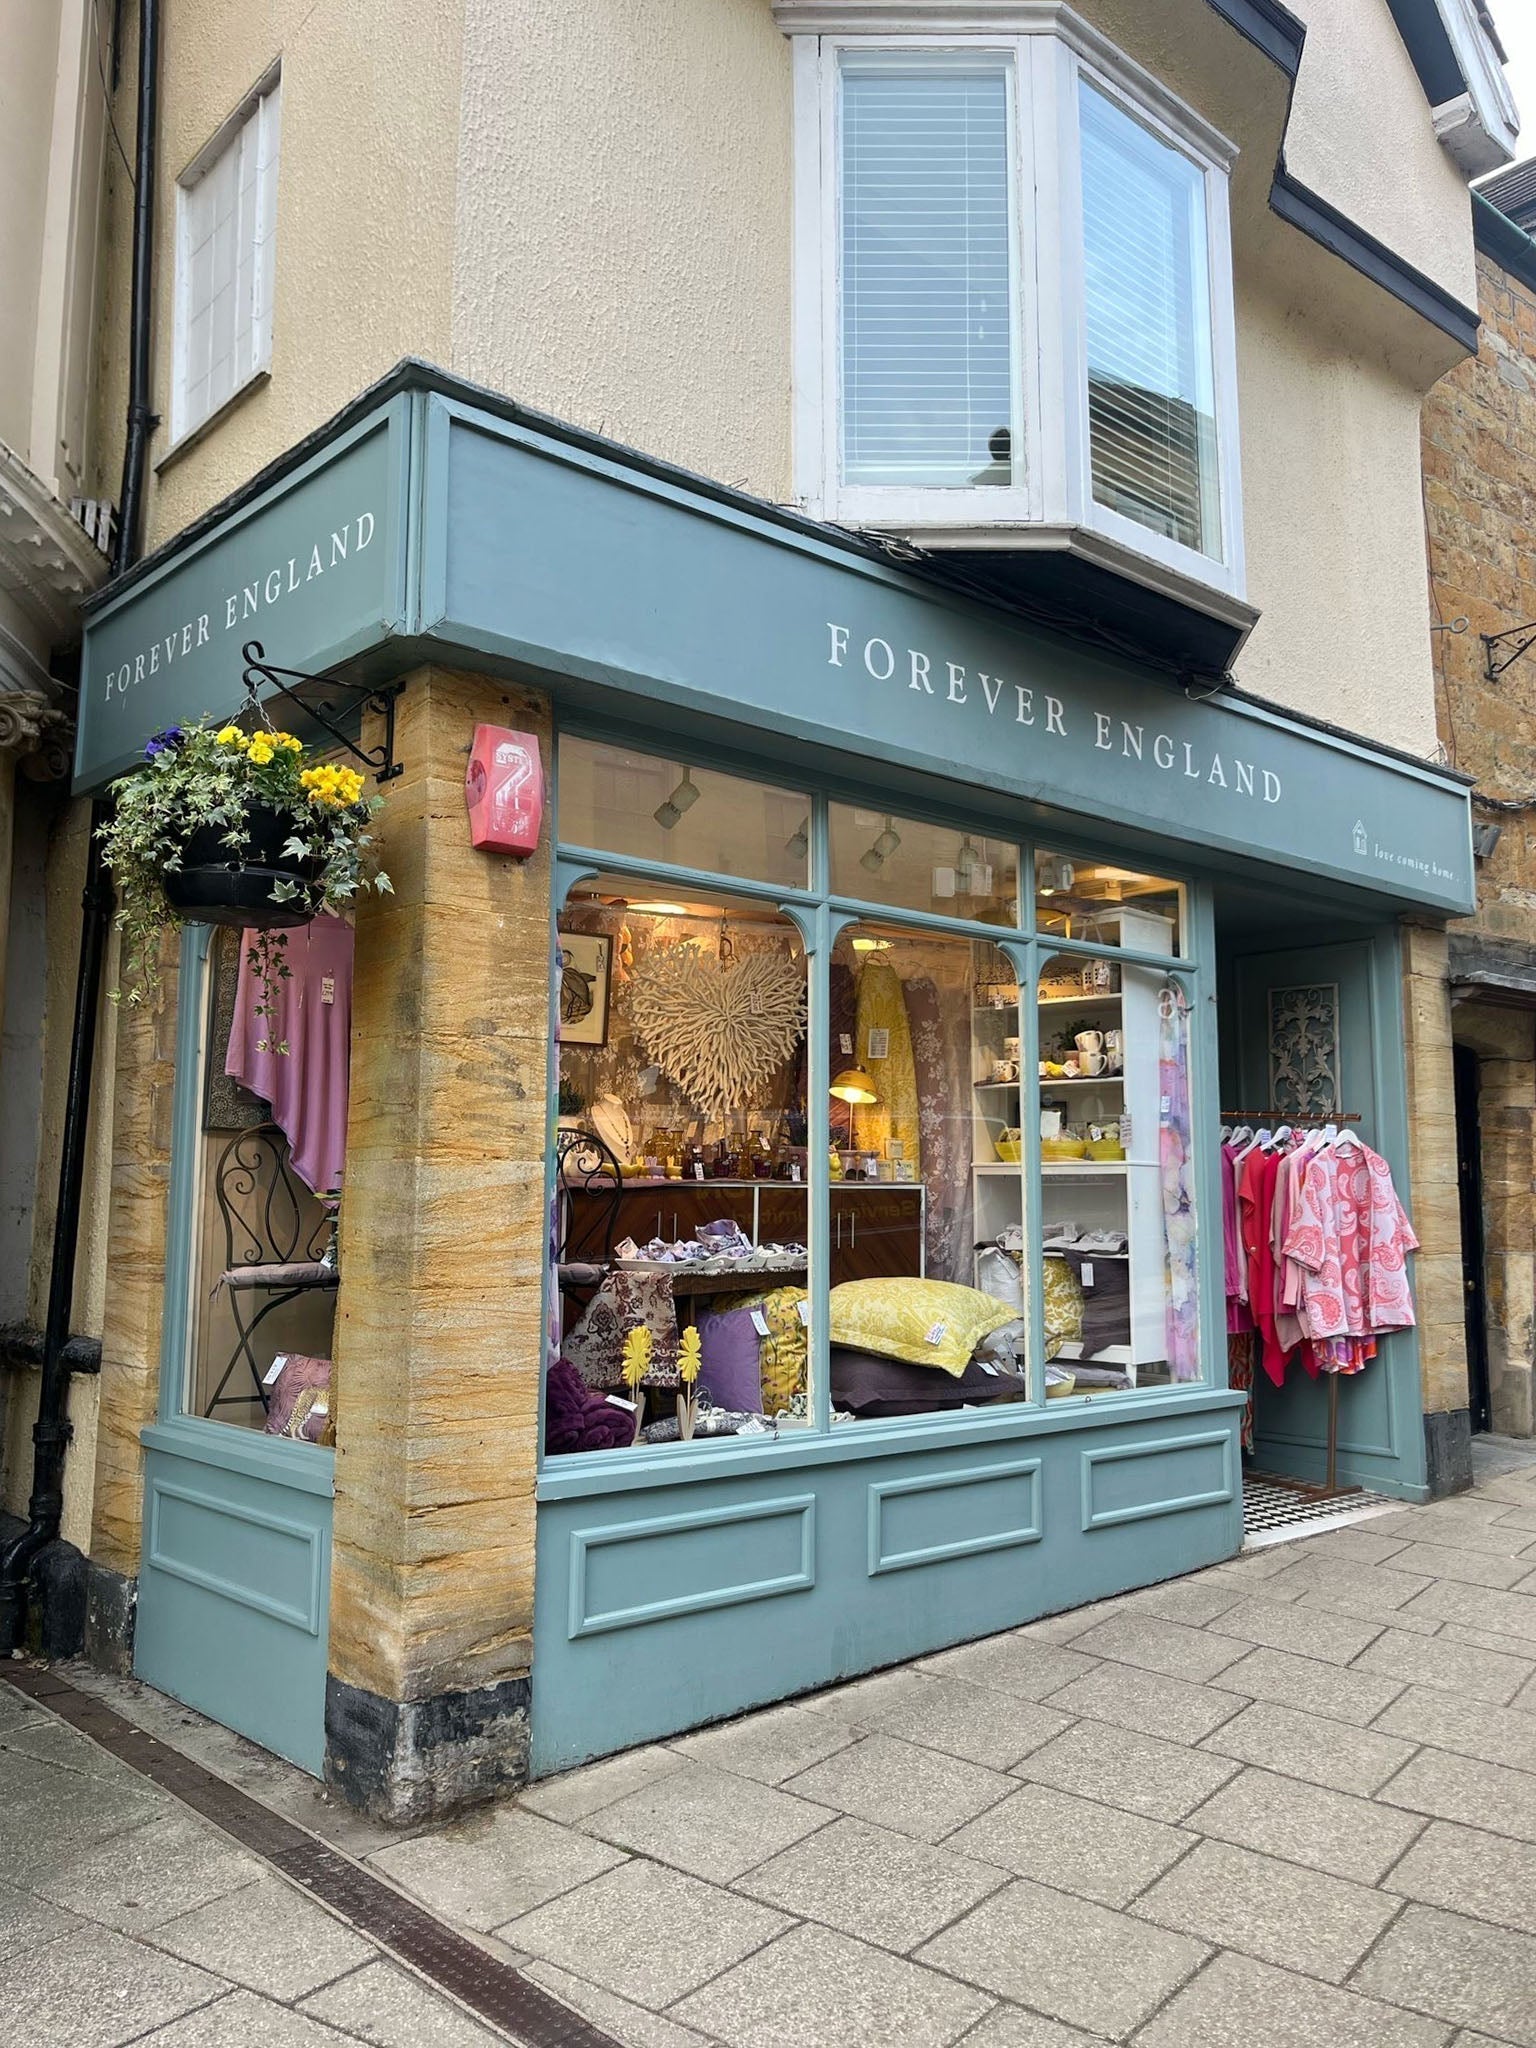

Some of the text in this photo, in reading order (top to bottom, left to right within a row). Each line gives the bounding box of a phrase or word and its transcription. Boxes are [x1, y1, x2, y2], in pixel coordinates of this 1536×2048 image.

[104, 512, 375, 702] FOREVER ENGLAND
[826, 622, 1283, 804] FOREVER ENGLAND
[1397, 855, 1429, 877] coming
